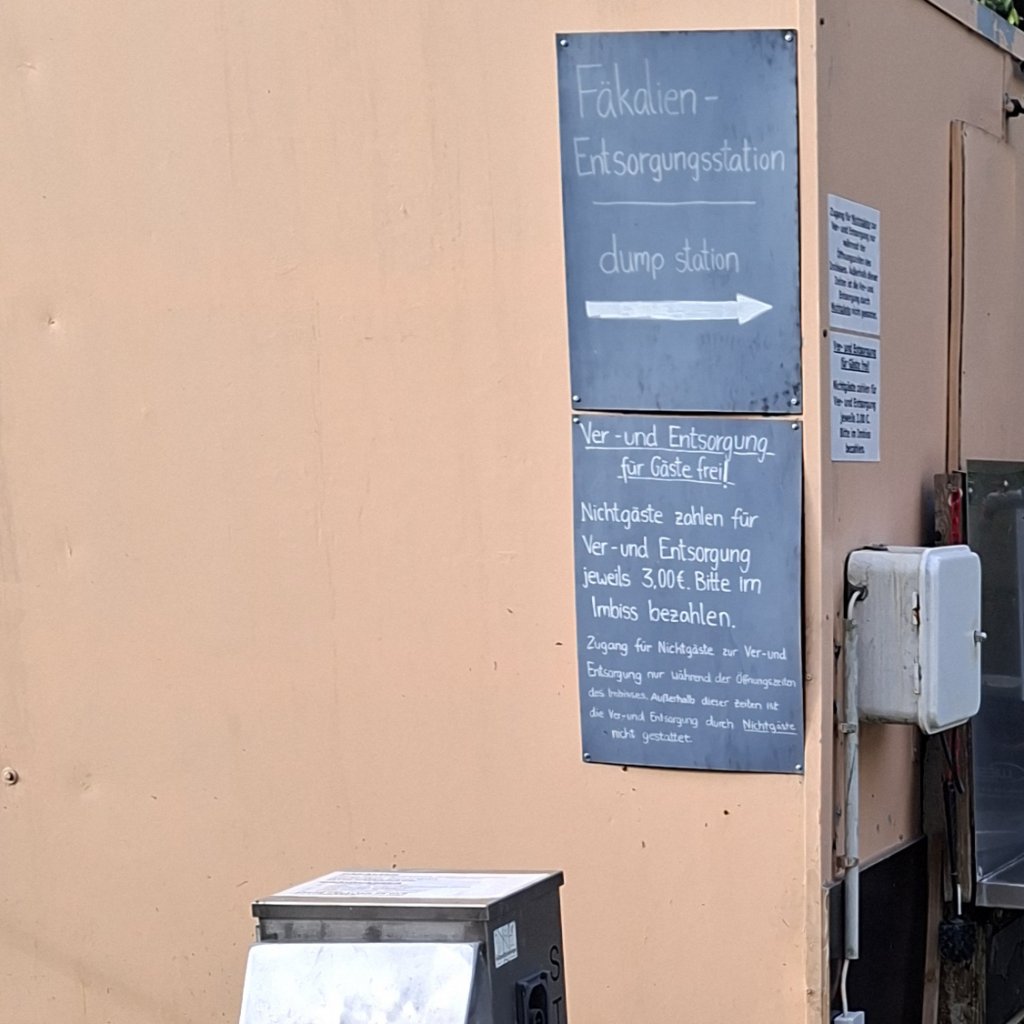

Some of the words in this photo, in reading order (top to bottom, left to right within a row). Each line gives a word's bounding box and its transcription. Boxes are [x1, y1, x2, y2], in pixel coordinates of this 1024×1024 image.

[573, 137, 785, 182] Entsorgungsstation
[599, 233, 665, 280] dump
[675, 238, 739, 272] station
[669, 425, 768, 462] Entsorgung
[620, 456, 645, 483] für
[651, 455, 693, 478] Gäste
[697, 457, 729, 488] frei!
[581, 502, 664, 529] Nichtgäste
[675, 506, 724, 527] zahlen
[731, 508, 759, 529] für
[658, 537, 751, 573] Entsorgung
[582, 566, 631, 588] jeweils
[695, 571, 732, 592] Bitte
[739, 576, 761, 594] im
[592, 596, 639, 621] Imbiss
[648, 600, 736, 628] bezahlen.
[586, 636, 629, 656] Zugang
[634, 638, 653, 653] für
[657, 641, 715, 658] Nichtgäste
[722, 648, 738, 657] zur
[587, 661, 642, 685] Entsorgung
[647, 671, 665, 679] nur
[671, 668, 711, 683] während
[715, 672, 732, 684] der
[588, 687, 605, 698] des
[650, 692, 696, 704] Außerhalb
[701, 696, 729, 707] dieser
[590, 706, 604, 718] die
[650, 711, 699, 728] Entsorgung
[705, 715, 734, 730] durch
[743, 719, 797, 734] Nichtgäste
